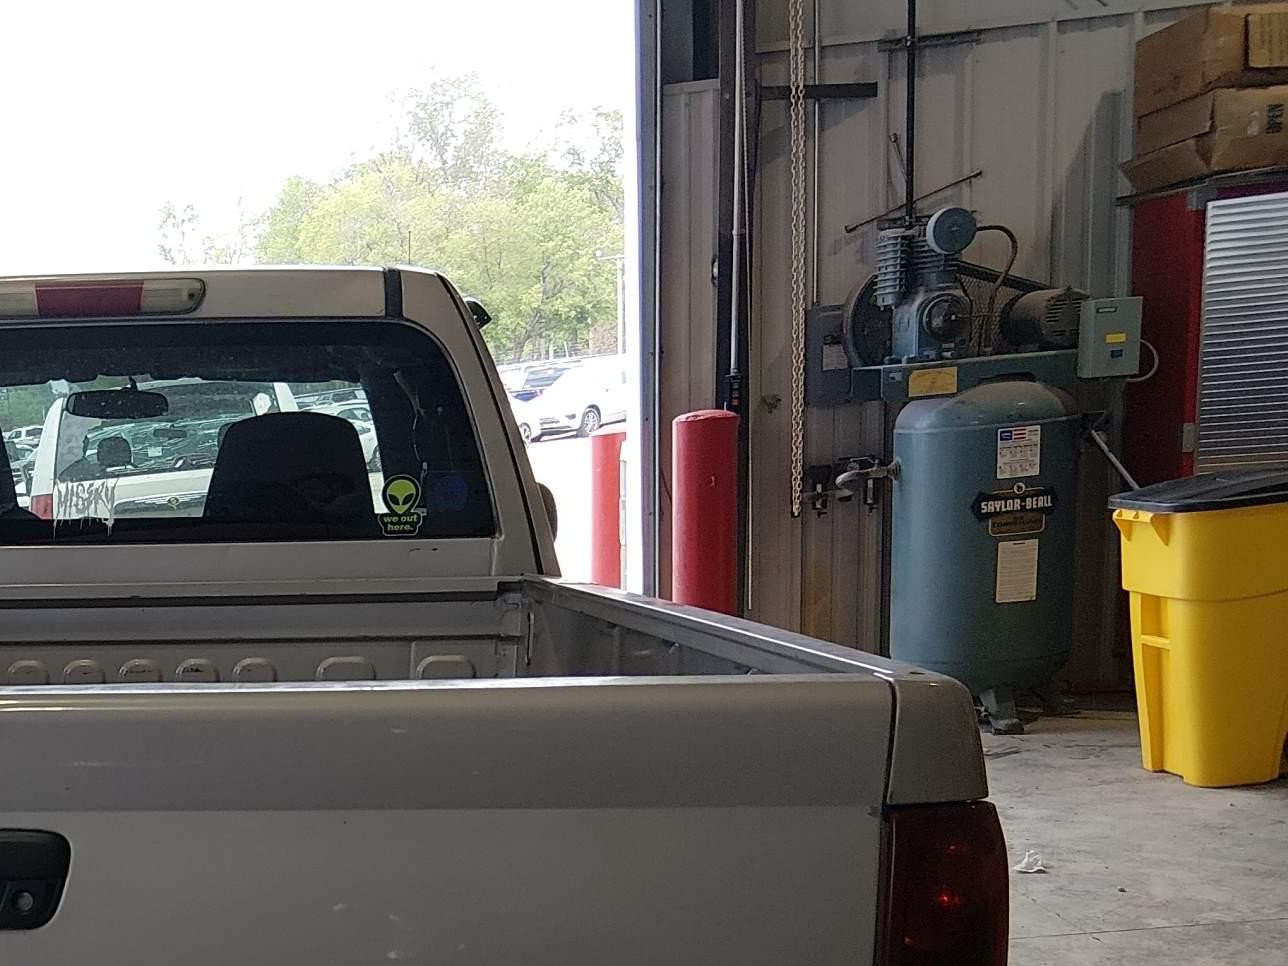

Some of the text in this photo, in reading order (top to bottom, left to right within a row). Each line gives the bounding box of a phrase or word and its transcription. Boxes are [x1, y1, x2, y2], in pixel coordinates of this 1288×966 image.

[53, 478, 119, 535] MISERY
[980, 495, 1053, 513] SAYLOR-BEALL
[400, 514, 418, 522] out
